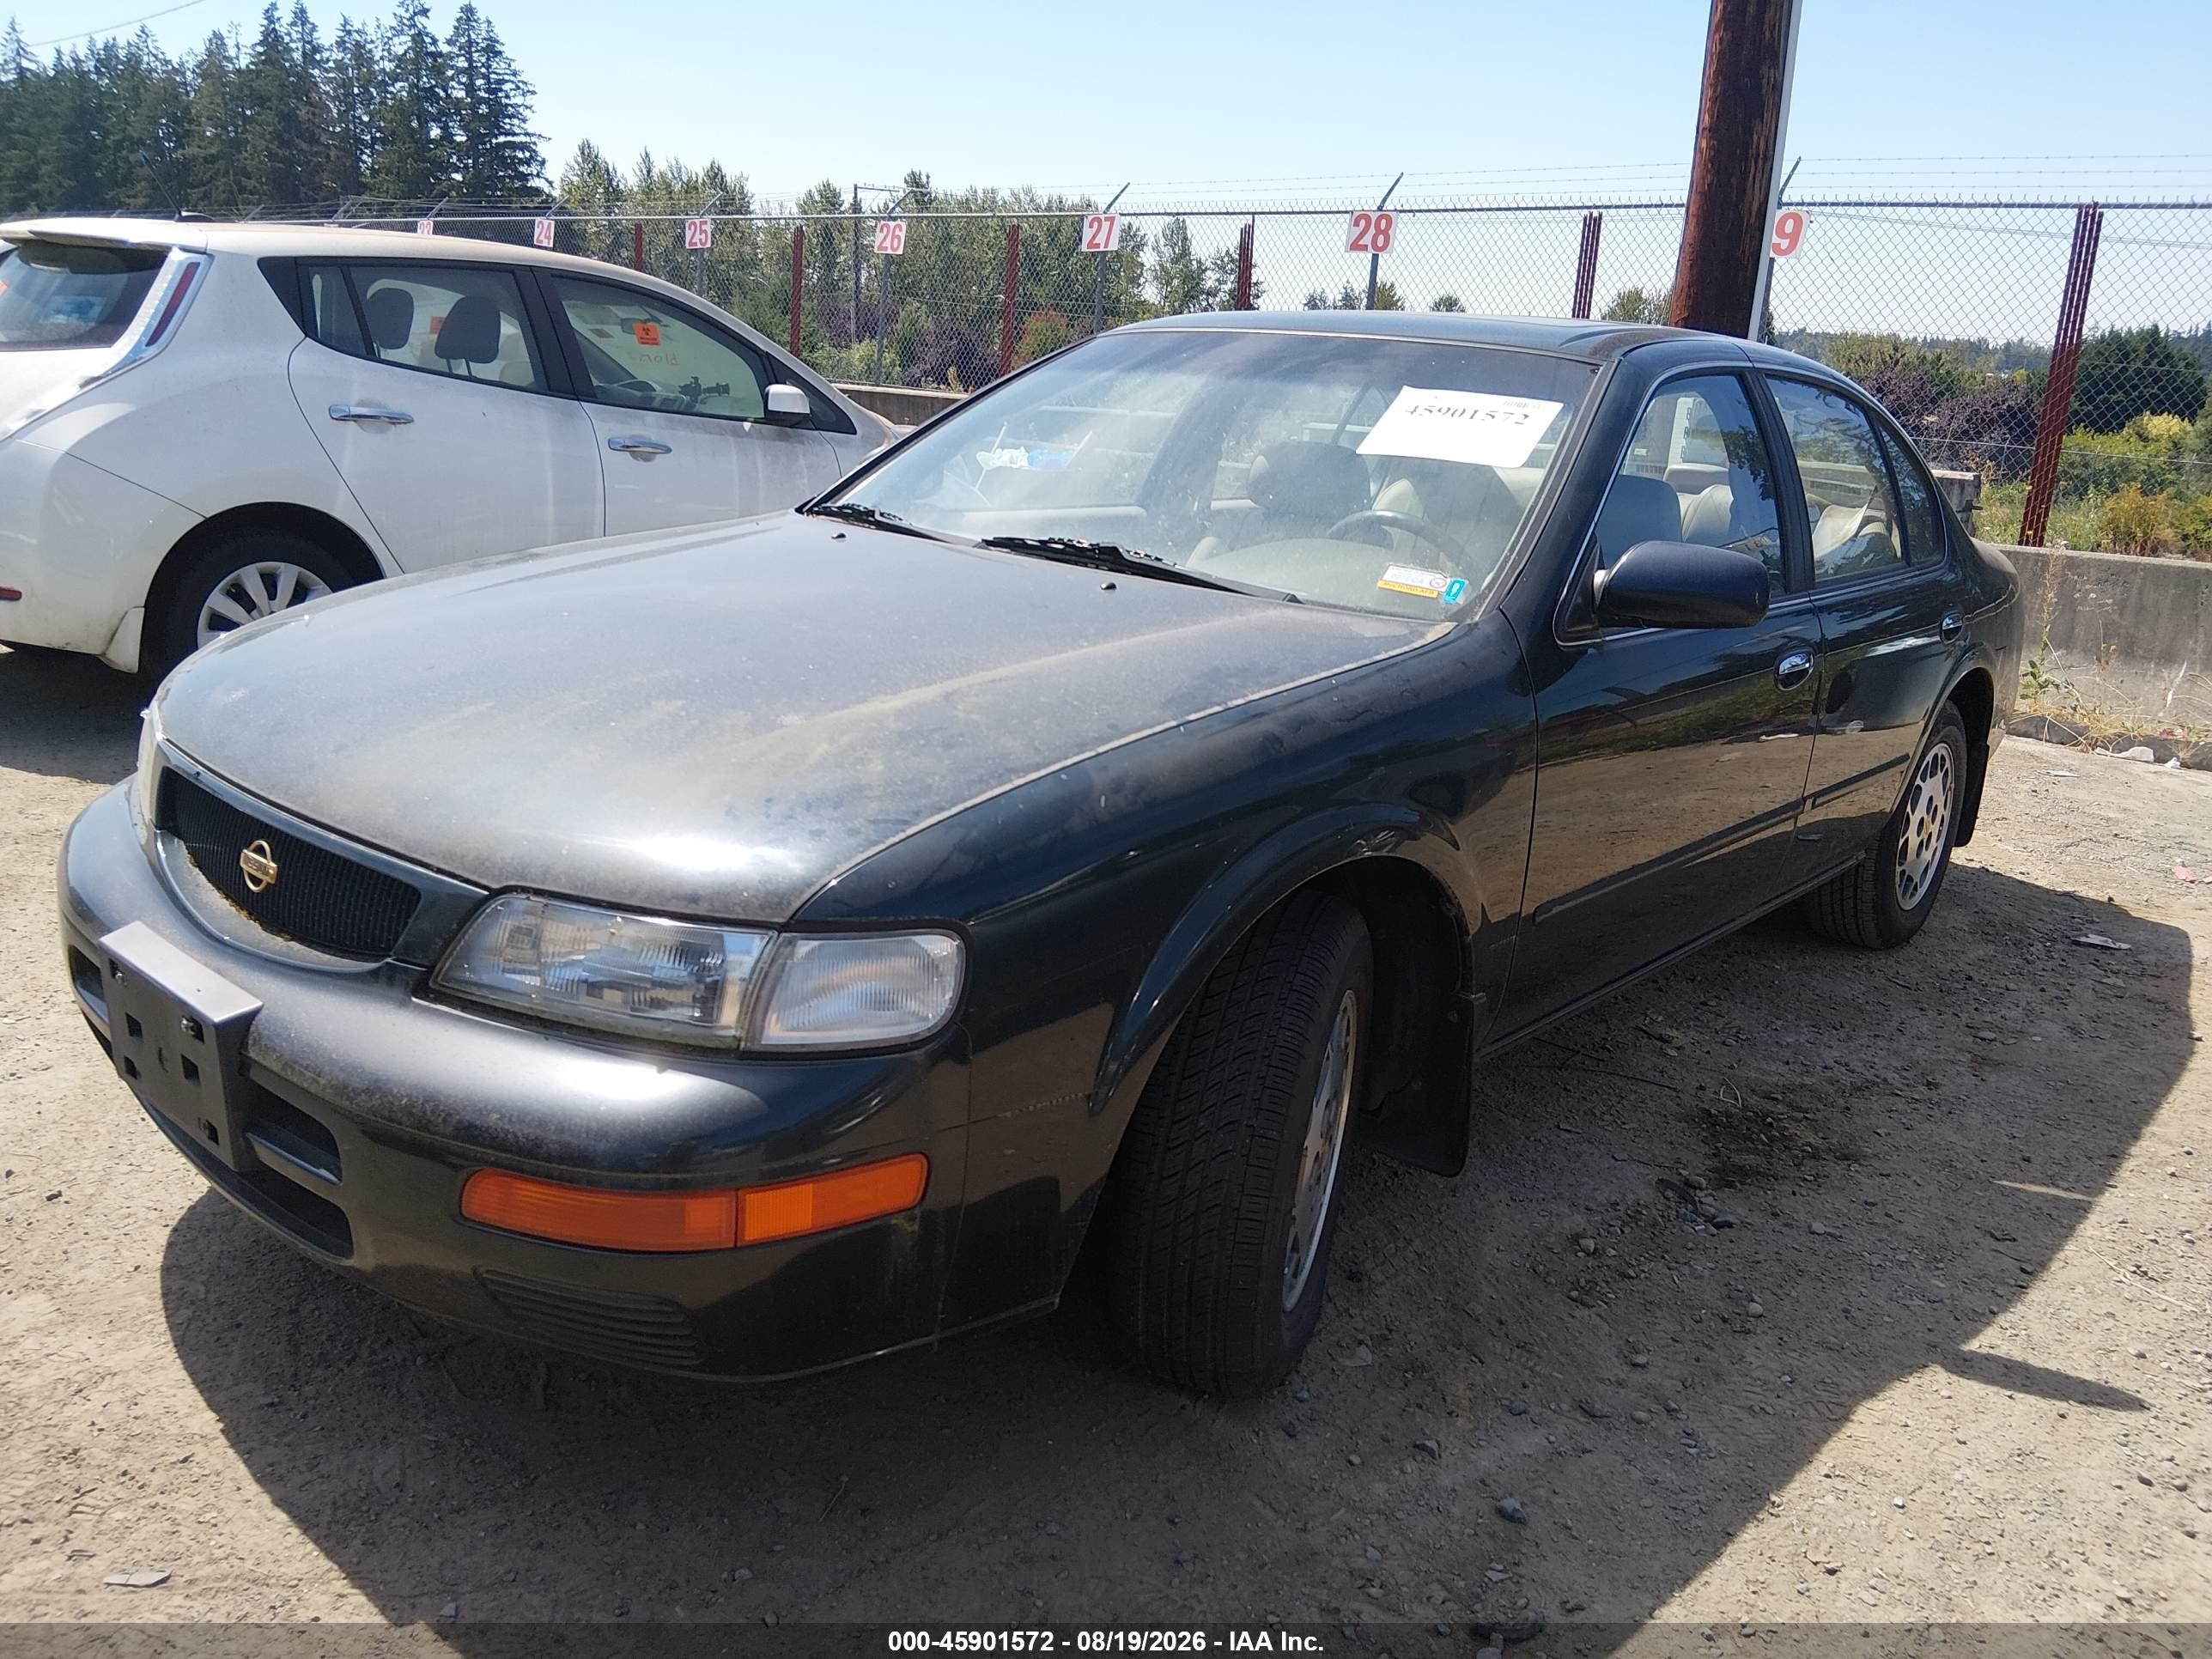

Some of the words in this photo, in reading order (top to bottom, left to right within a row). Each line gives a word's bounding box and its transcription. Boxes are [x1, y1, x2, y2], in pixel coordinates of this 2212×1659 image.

[536, 220, 553, 246] 24
[688, 219, 708, 248] 25
[878, 222, 904, 252] 26
[1087, 216, 1115, 250] 27
[1350, 213, 1393, 252] 28
[1771, 213, 1804, 256] 9
[1405, 404, 1530, 426] 45901572
